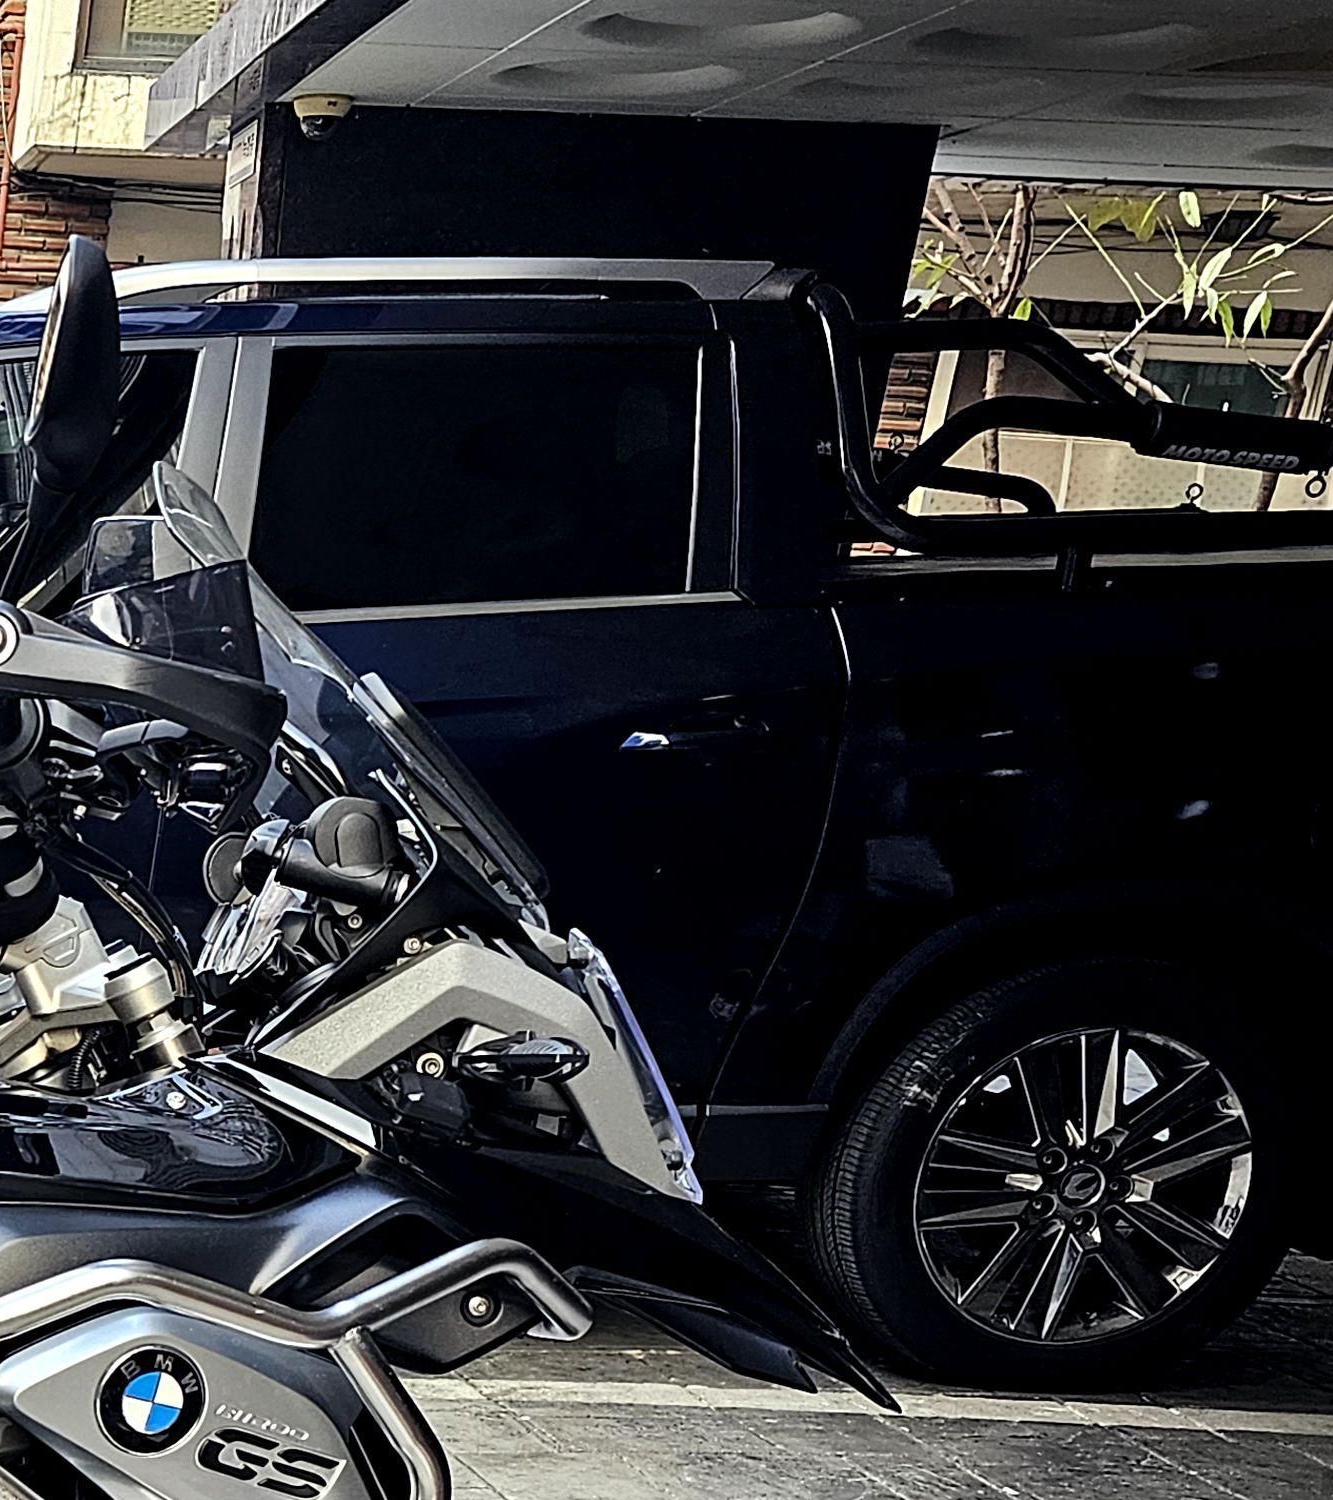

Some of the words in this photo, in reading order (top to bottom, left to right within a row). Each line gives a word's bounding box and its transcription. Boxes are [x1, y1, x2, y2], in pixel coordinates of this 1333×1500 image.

[1161, 444, 1231, 462] MOTO
[1229, 450, 1300, 469] SPEED
[121, 1353, 199, 1394] BMW
